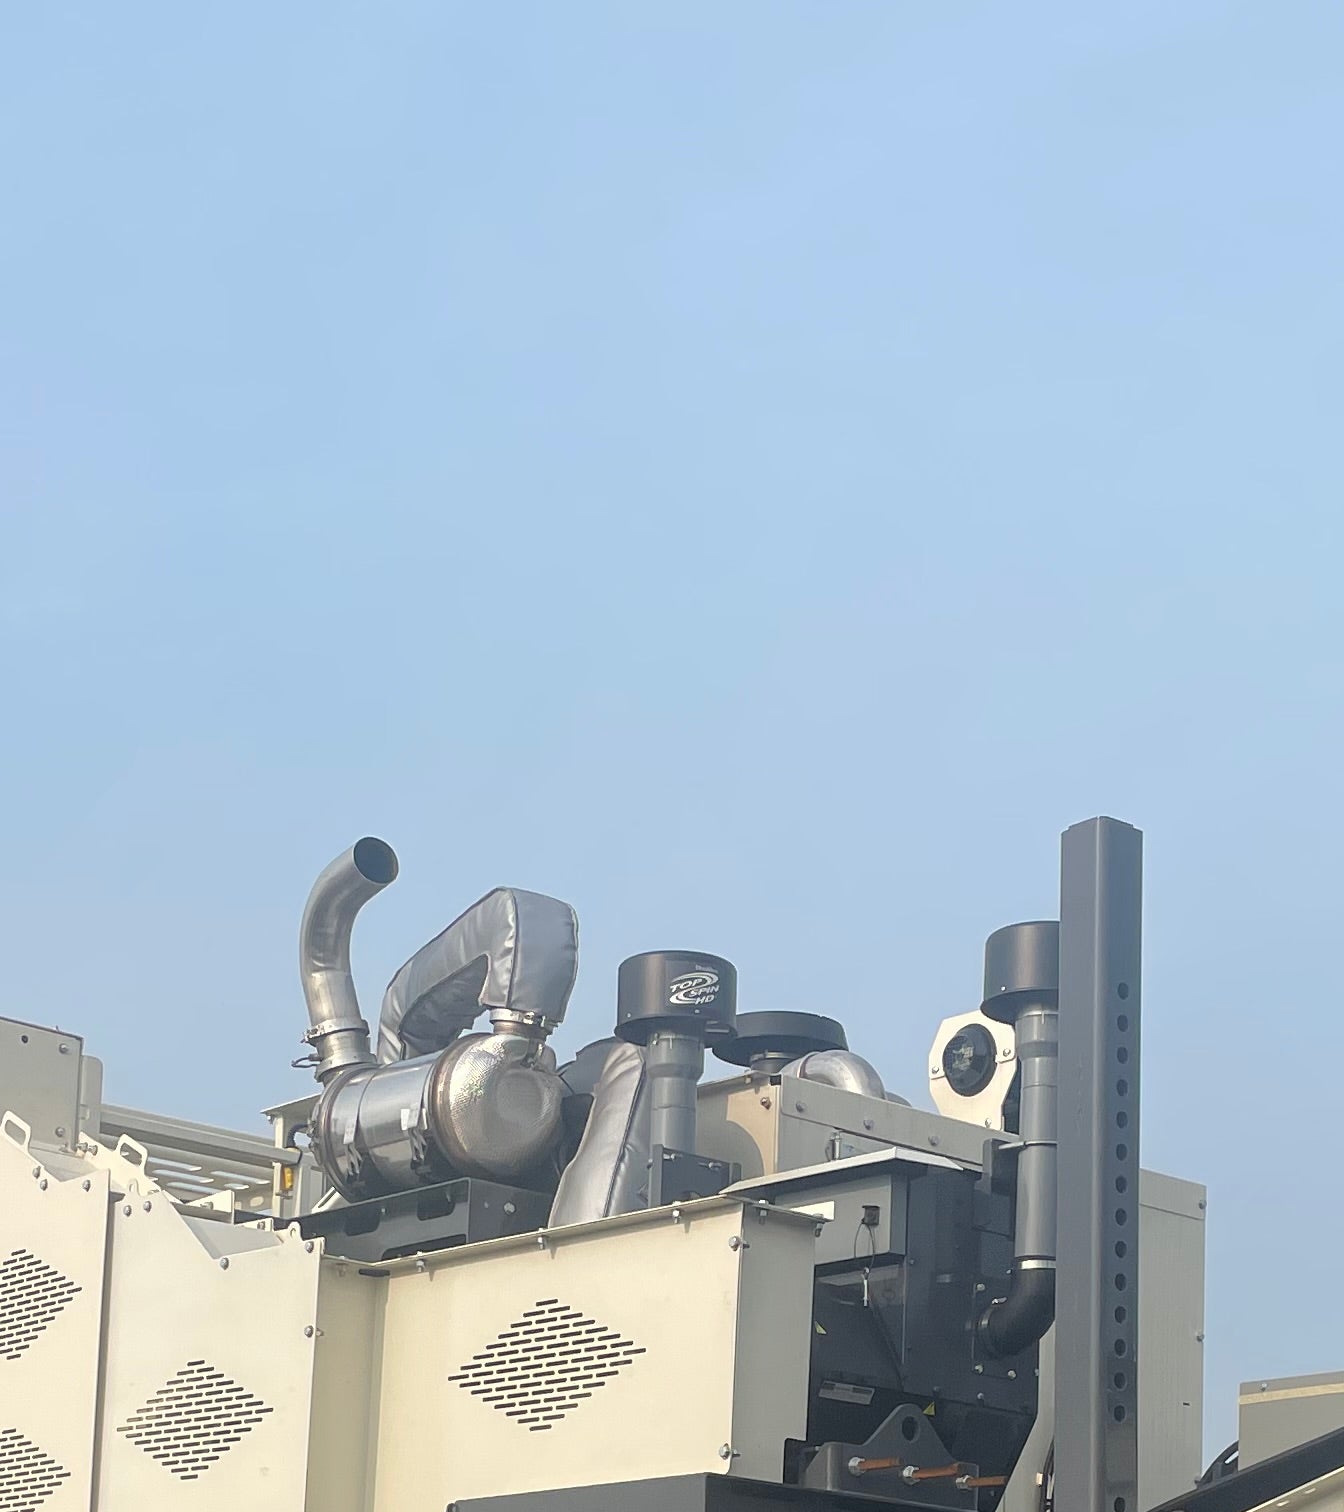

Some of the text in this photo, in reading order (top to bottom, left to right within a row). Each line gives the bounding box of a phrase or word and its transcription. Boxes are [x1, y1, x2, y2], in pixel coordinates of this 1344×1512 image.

[670, 978, 703, 992] TOP
[689, 985, 720, 998] SPIN
[695, 995, 715, 1005] HD
